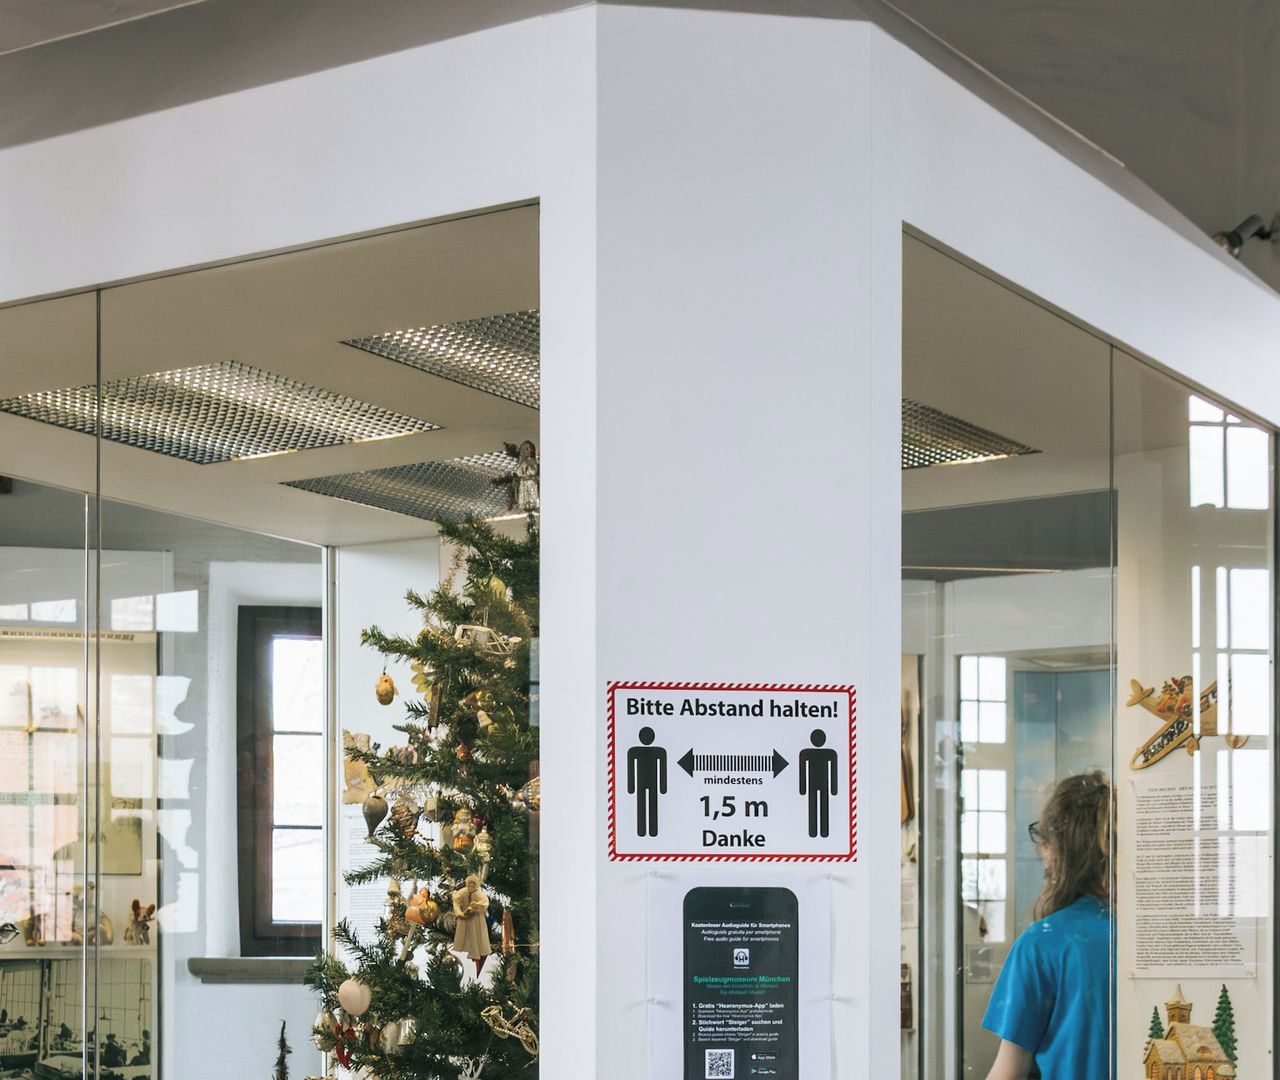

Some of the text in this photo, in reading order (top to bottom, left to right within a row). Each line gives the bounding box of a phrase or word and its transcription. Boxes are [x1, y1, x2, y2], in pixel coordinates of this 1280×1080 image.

[626, 698, 839, 718] Bitte Abstand halten!
[704, 775, 763, 785] mindestens
[699, 796, 769, 821] 1,5 m
[702, 829, 766, 847] Danke
[758, 974, 791, 983] München
